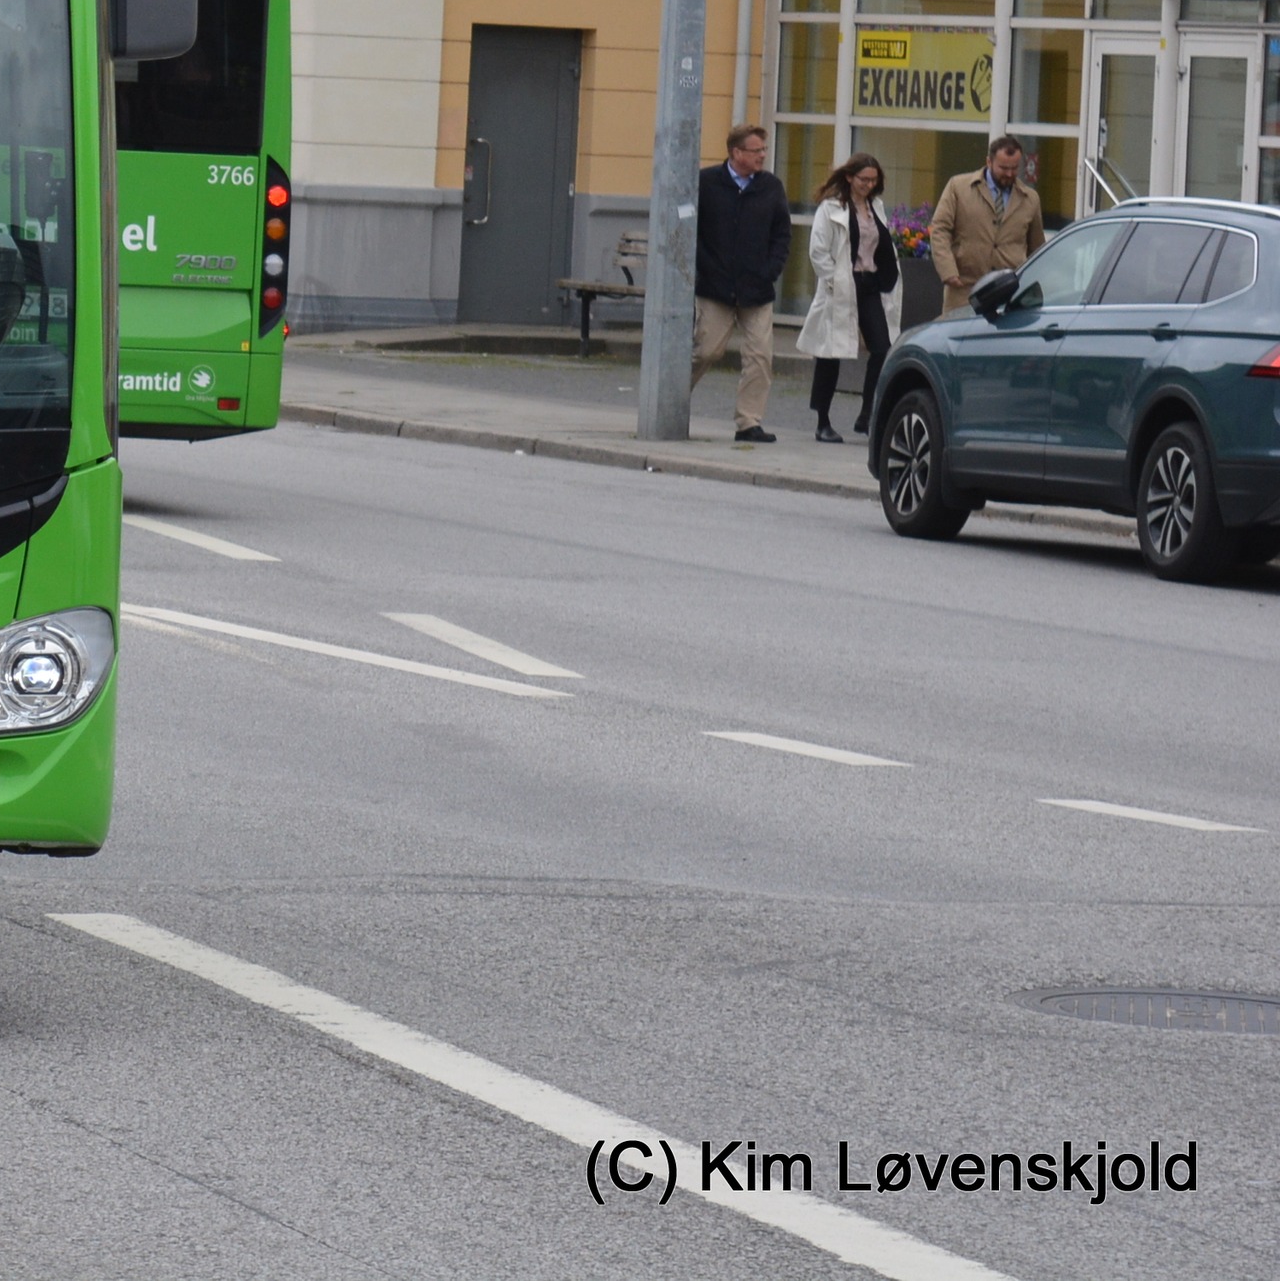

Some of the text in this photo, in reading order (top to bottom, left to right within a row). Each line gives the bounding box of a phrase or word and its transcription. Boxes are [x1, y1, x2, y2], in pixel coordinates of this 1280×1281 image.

[870, 49, 888, 57] UNION
[858, 67, 965, 110] EXCHANGE
[207, 165, 255, 186] 3766
[122, 215, 158, 252] el
[175, 254, 237, 270] 7900
[118, 372, 181, 392] ramtid
